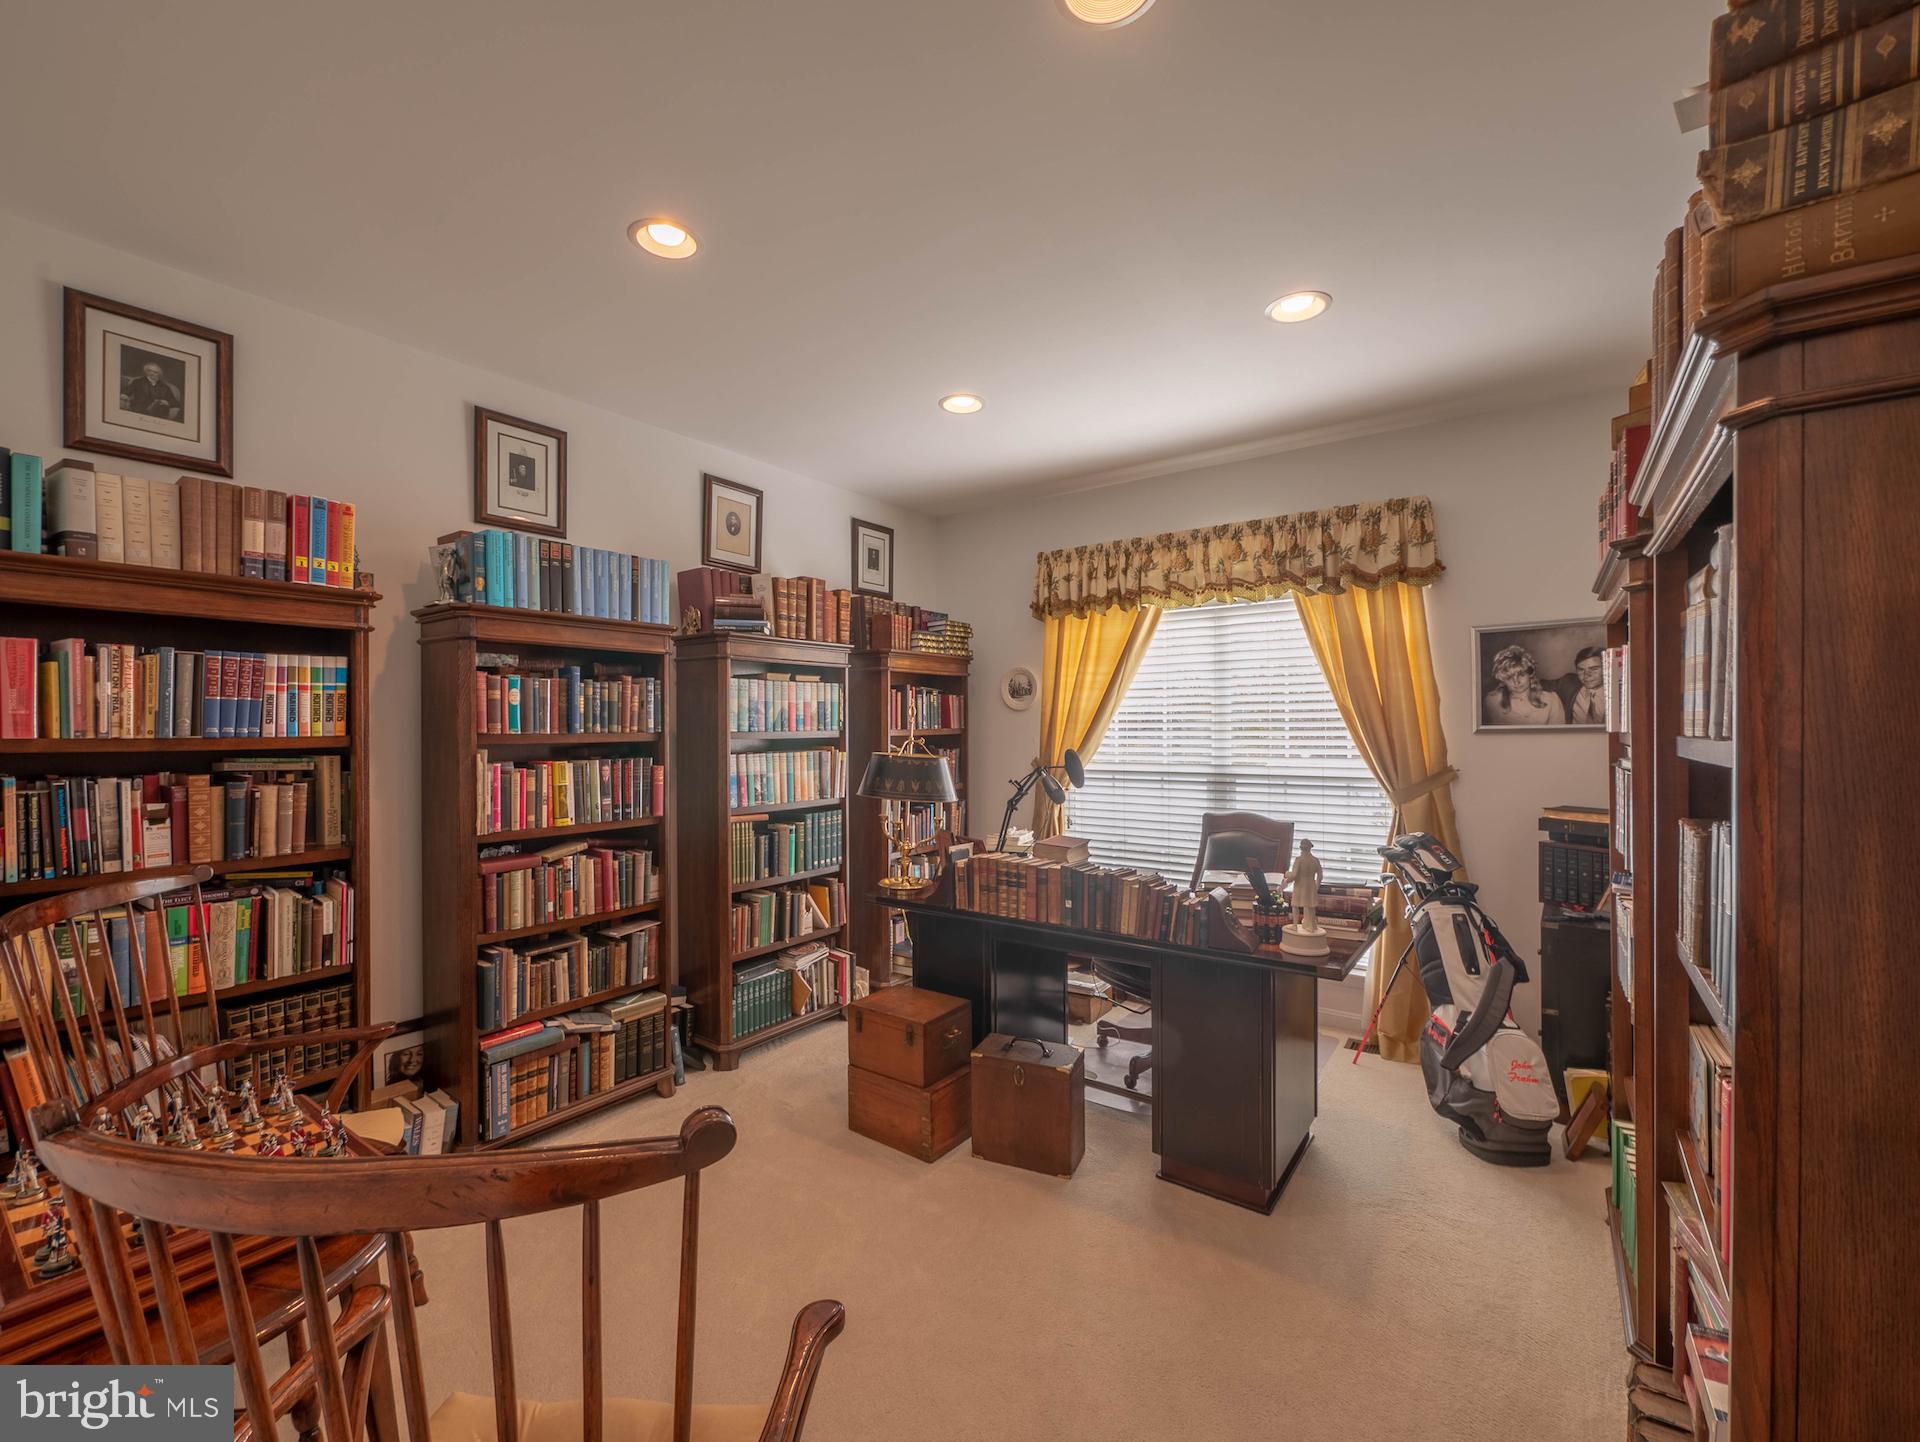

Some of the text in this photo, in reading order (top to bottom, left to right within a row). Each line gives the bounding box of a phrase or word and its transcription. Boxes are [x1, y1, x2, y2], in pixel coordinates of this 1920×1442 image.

[1794, 168, 1807, 196] THE
[298, 560, 305, 568] 1
[316, 560, 323, 568] 2
[112, 648, 120, 716] FAITH ON TRIAL
[265, 693, 274, 724] ROMANS
[313, 692, 322, 723] ROMANS
[325, 692, 335, 723] ROMANS
[336, 692, 346, 723] ROMANS
[174, 896, 192, 904] ELECT
[1511, 1060, 1533, 1070] John
